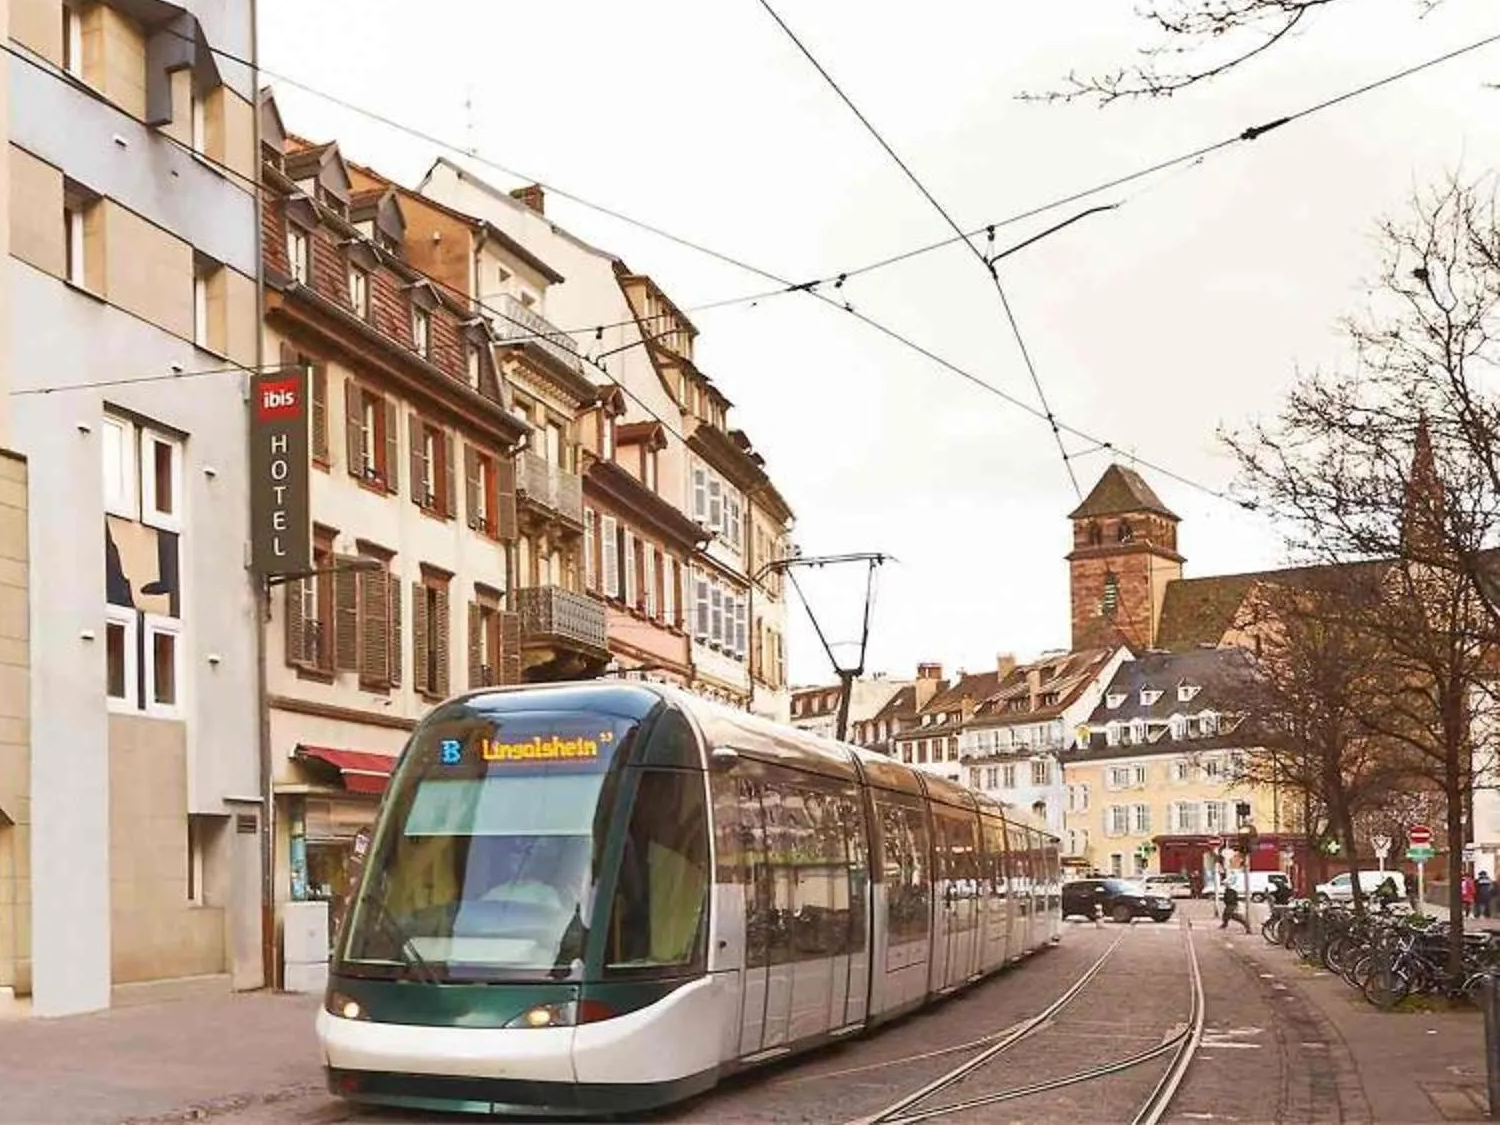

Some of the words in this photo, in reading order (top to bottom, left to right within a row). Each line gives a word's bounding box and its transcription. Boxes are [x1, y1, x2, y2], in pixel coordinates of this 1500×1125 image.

[263, 389, 295, 409] ibis
[271, 434, 287, 556] HOTEL
[441, 739, 461, 763] B
